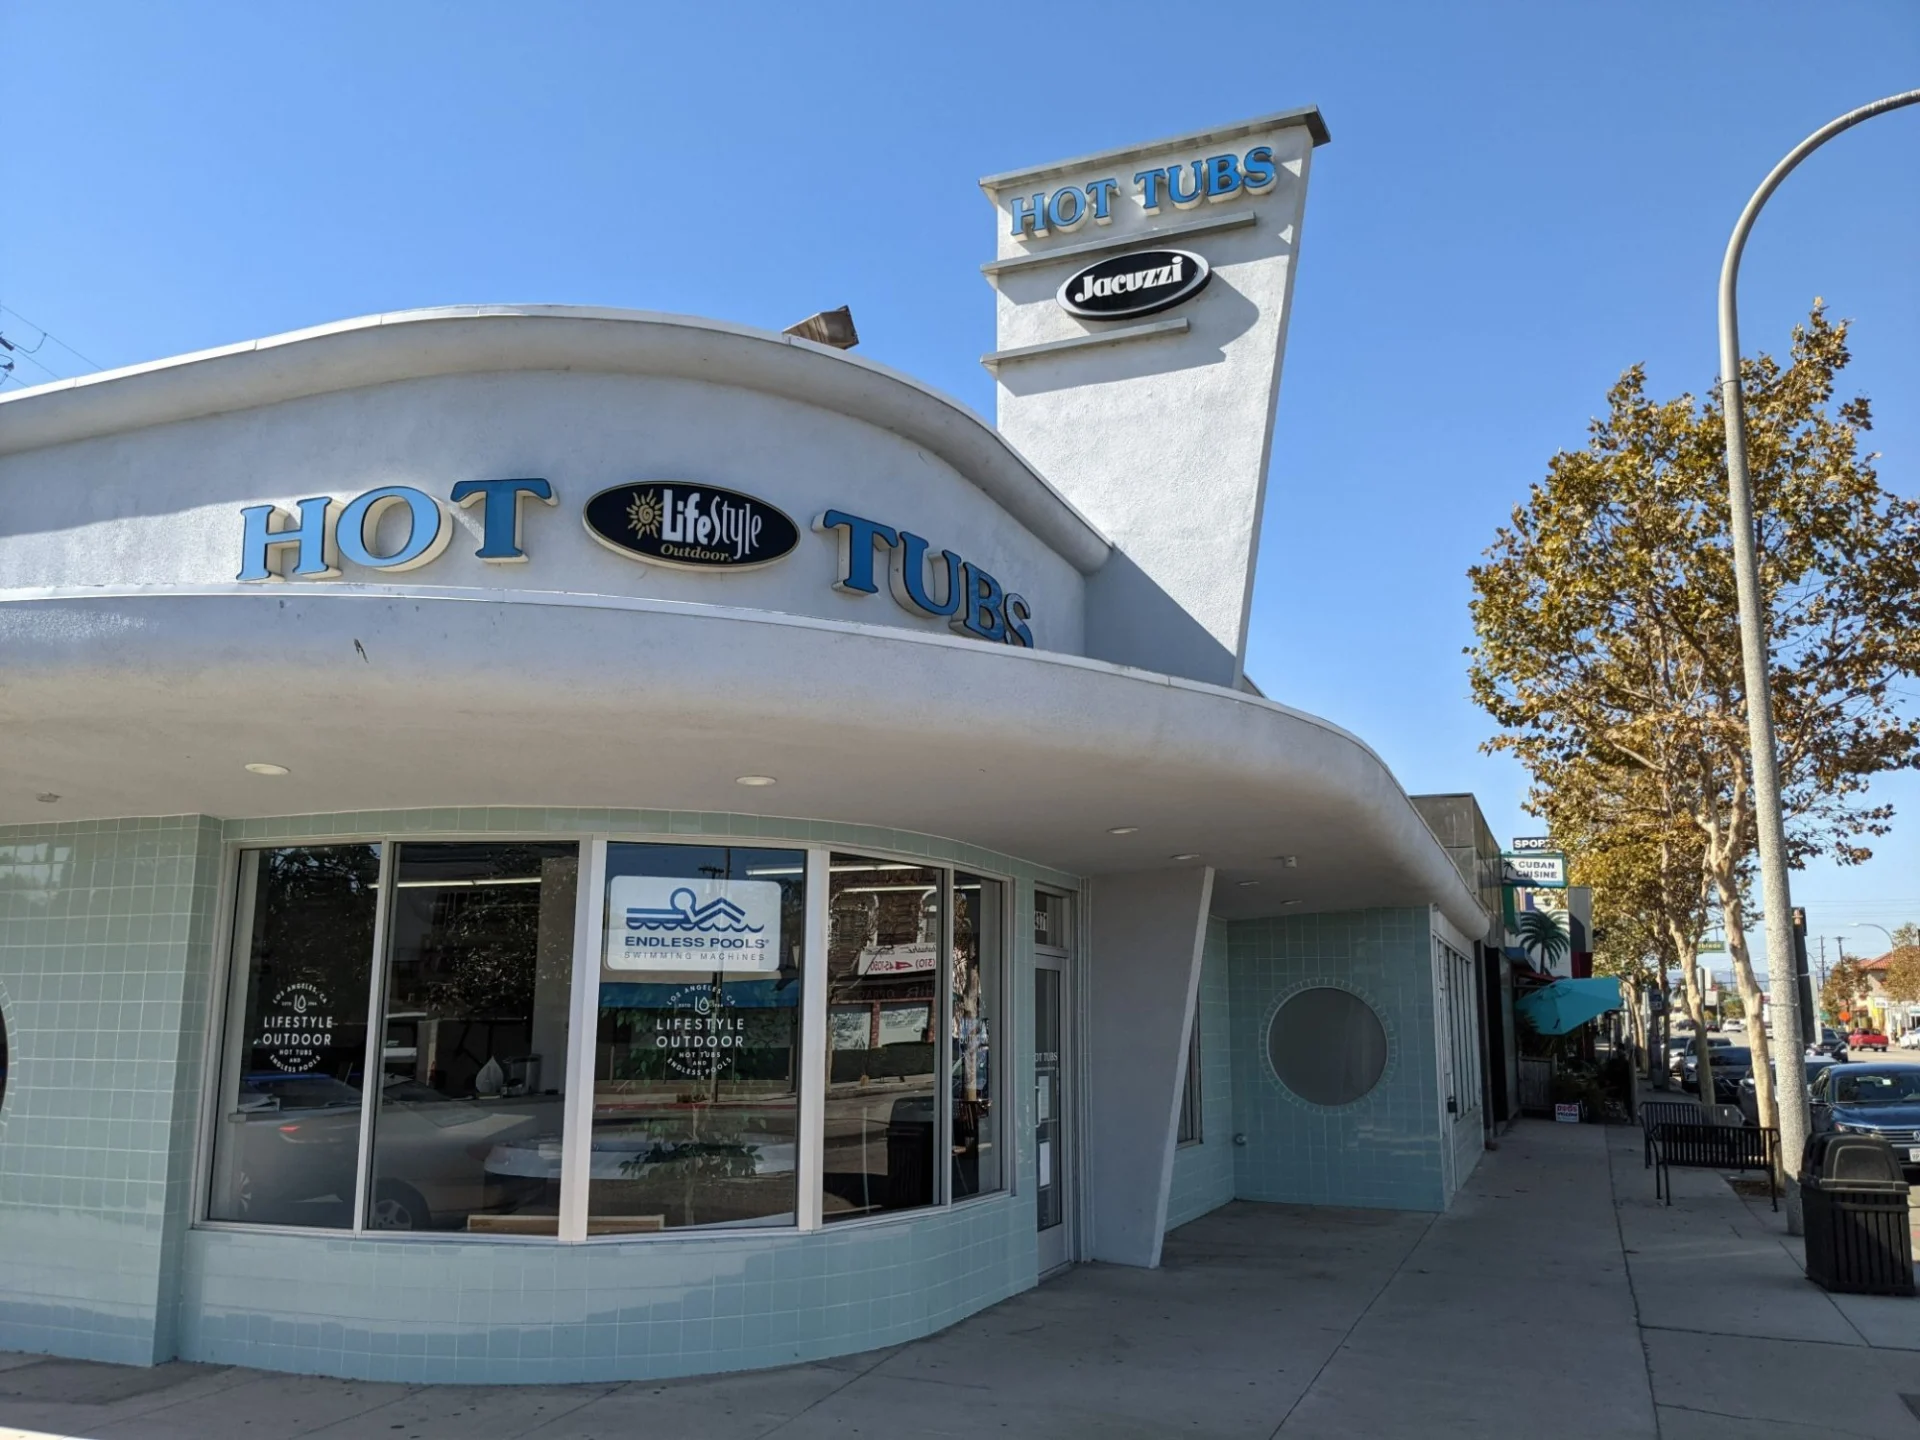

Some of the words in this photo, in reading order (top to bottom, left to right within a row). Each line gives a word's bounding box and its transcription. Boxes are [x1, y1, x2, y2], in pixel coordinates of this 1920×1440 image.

[1010, 178, 1119, 239] HOT
[1134, 146, 1277, 214] TUBS
[1074, 255, 1183, 303] Jacuzzi
[236, 477, 558, 583] HOT
[661, 488, 762, 560] LifeStyle
[813, 508, 1034, 648] TUBS
[1518, 861, 1555, 869] CUBAN
[1516, 870, 1557, 878] CUISINE
[625, 936, 704, 948] ENDLESS
[624, 951, 692, 960] SWIMMING
[701, 952, 765, 961] MACHINES
[272, 990, 285, 1004] LOS
[666, 991, 681, 1006] LOS
[264, 1016, 333, 1028] LIFESTYLE
[656, 1018, 744, 1030] LIFESTYLE
[262, 1033, 332, 1045] OUTDOOR
[656, 1036, 743, 1047] OUTDOOR
[269, 1054, 296, 1073] ENDLESS
[299, 1055, 321, 1072] POOLS
[667, 1057, 701, 1075] ENDLESS
[705, 1057, 732, 1074] POOLS
